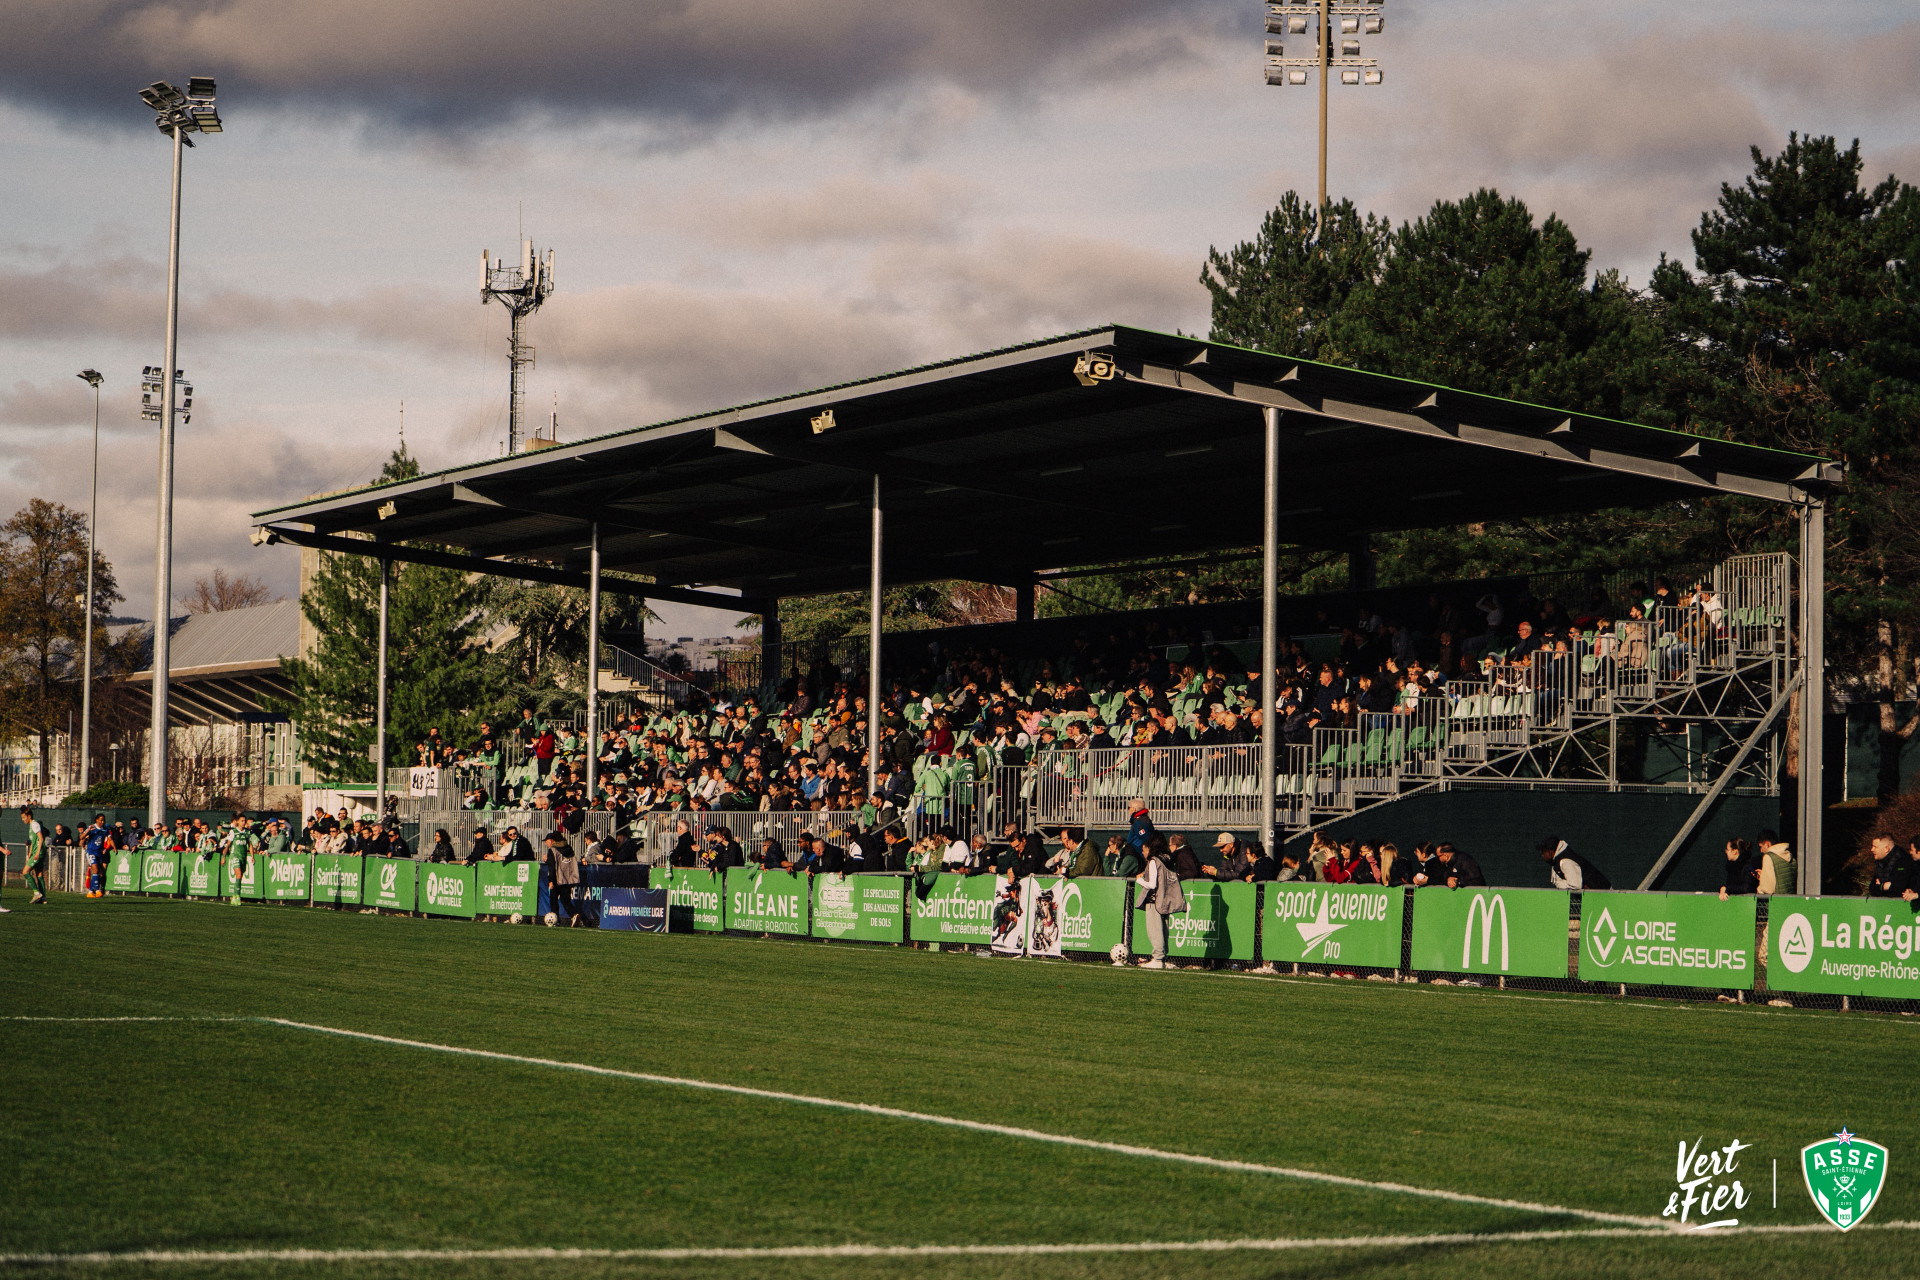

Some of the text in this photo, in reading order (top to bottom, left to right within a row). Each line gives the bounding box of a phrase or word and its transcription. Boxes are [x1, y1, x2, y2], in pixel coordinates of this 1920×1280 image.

[144, 854, 174, 883] Casino
[437, 876, 464, 896] AÉSIO
[484, 883, 523, 897] SAINT-ÉTIENNE
[863, 888, 900, 899] LE SPECIALISTE
[437, 896, 462, 908] MUTUELLE
[490, 898, 523, 914] la métropole
[863, 902, 900, 913] DES ANALYSES
[1275, 888, 1388, 922] sport avenue
[608, 906, 630, 916] ARKEMA
[652, 908, 664, 918] LIGUE
[702, 913, 719, 926] design
[733, 918, 799, 934] ADAPTIVE ROBOTICS
[870, 917, 892, 927] DE SOLS
[940, 921, 992, 935] Ville créative des
[1624, 920, 1677, 942] LOIRE
[1821, 913, 1920, 960] La Régi
[1187, 939, 1216, 948] PISCINES
[1323, 939, 1341, 960] pro
[1621, 945, 1747, 970] ASCENSEURS
